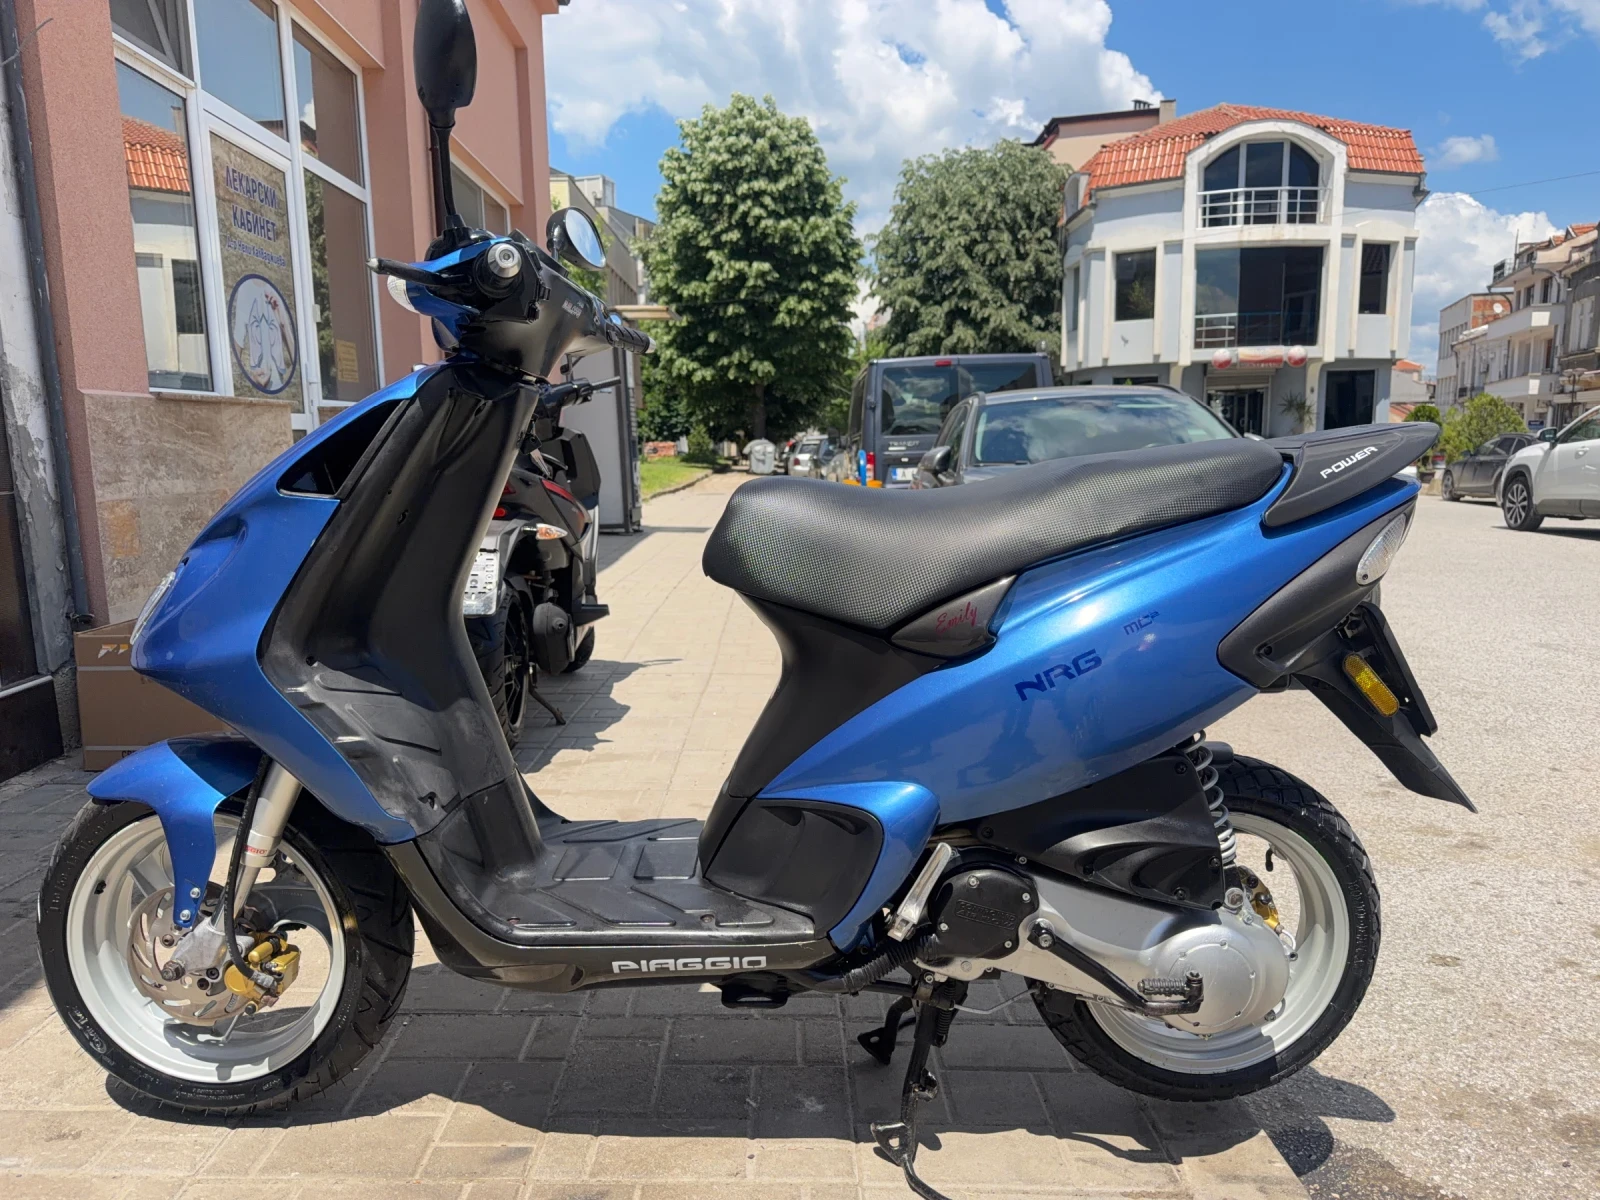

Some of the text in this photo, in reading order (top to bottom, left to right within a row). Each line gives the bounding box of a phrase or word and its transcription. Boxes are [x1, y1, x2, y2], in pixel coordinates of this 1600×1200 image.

[226, 165, 277, 209] ЛЕКАРСКИ
[232, 204, 276, 242] КАБИНЕТ
[1320, 446, 1378, 479] POWER
[936, 601, 978, 635] Emily
[1014, 648, 1102, 702] NRG
[611, 955, 767, 974] PIAGGIO
